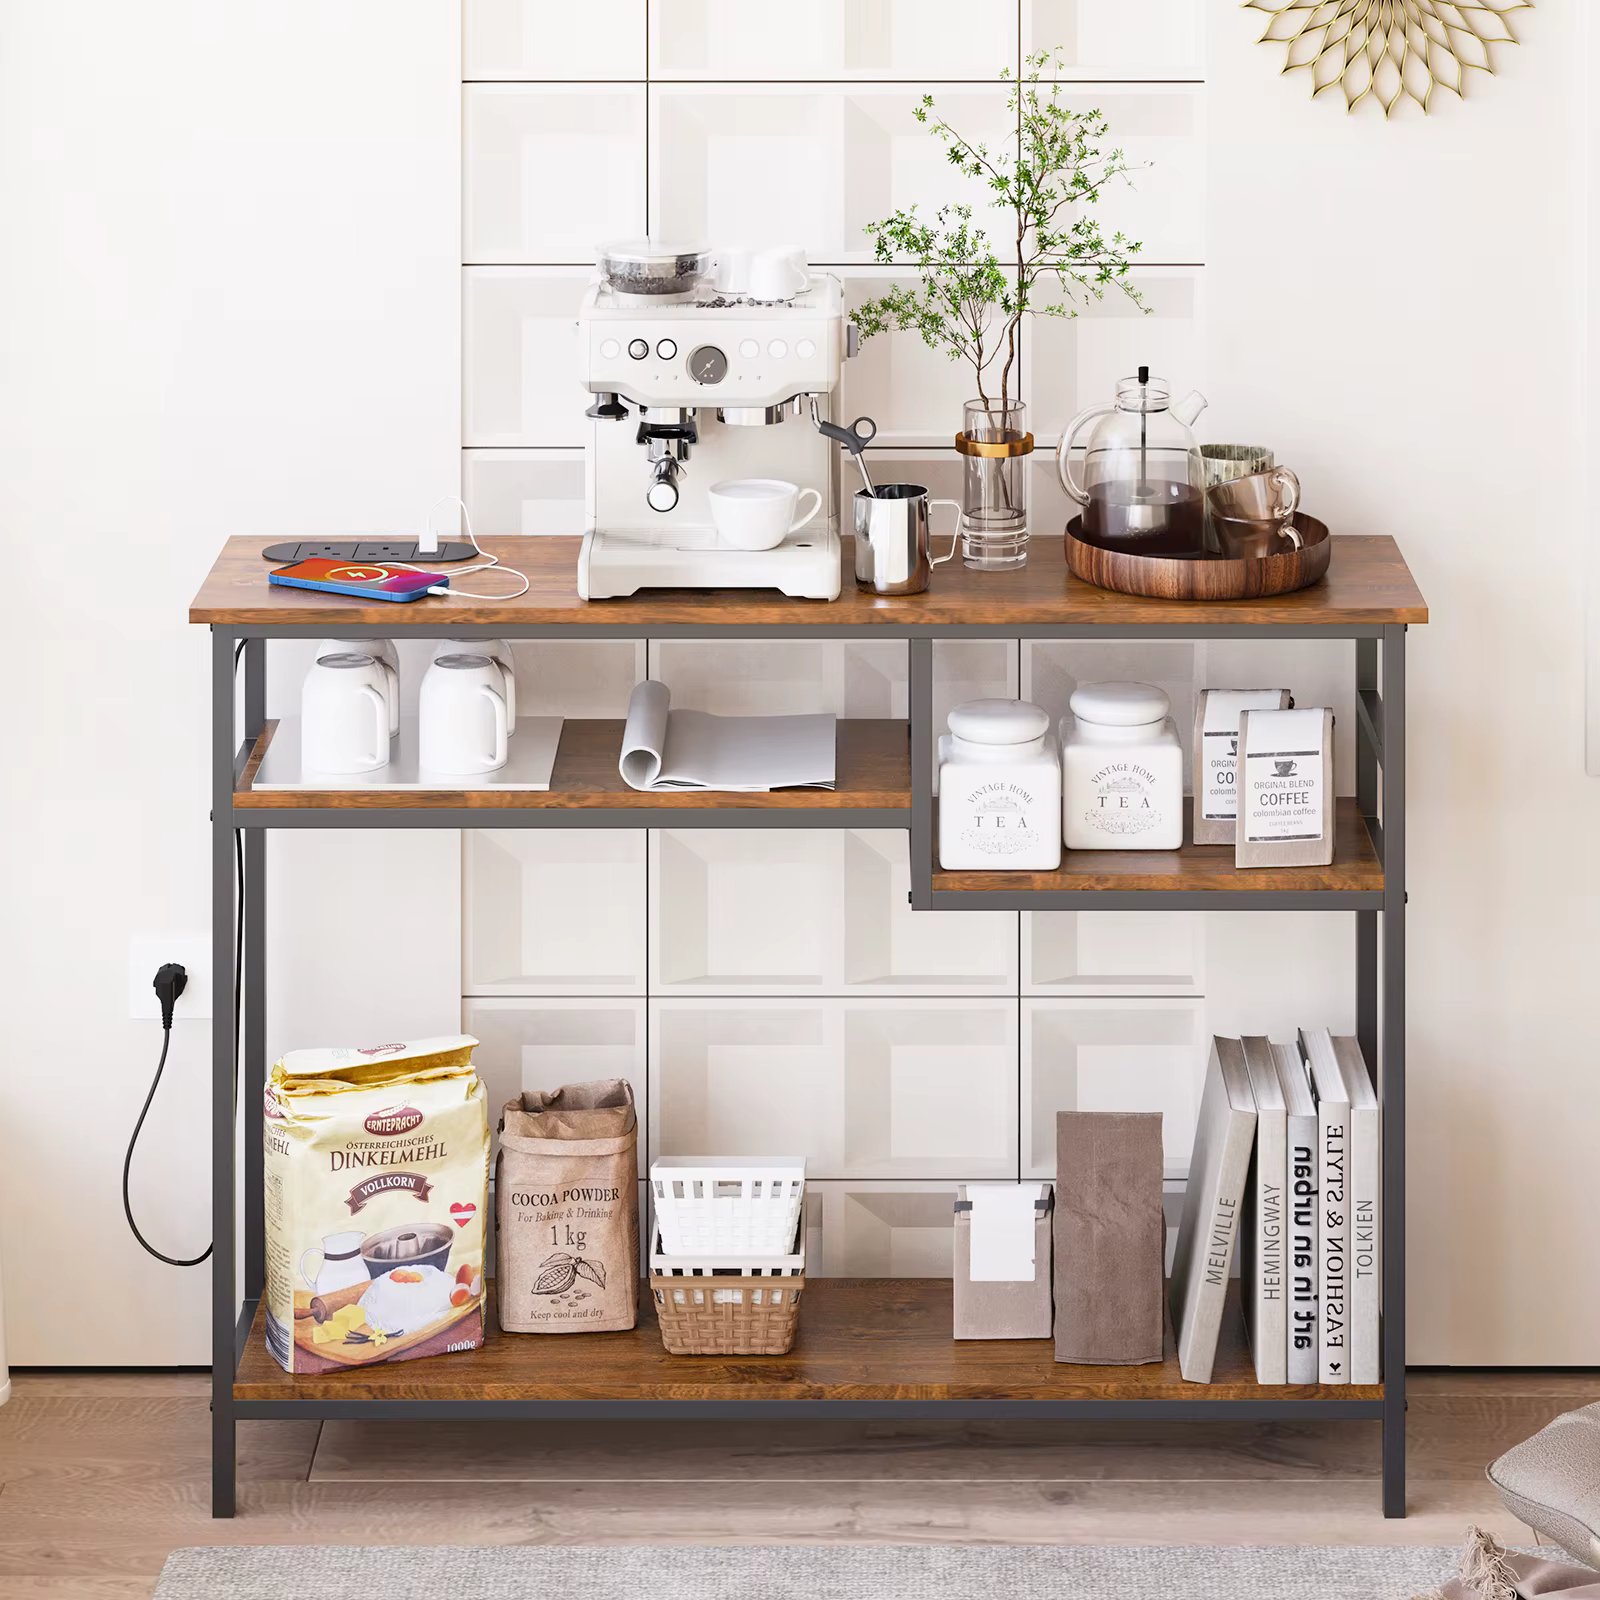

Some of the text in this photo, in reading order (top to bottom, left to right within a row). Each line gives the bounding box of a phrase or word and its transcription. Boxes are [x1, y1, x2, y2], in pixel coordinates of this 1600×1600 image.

[1091, 764, 1158, 786] VINTAGE HOME
[968, 782, 1034, 805] VINTAGE HOME
[1254, 780, 1314, 790] ORGINAL BLEND
[1260, 792, 1310, 806] COFFEE
[1252, 808, 1316, 818] colombian coffee
[366, 1114, 421, 1132] ERNTEPRACHT
[346, 1134, 435, 1150] ÖSTERREICHISCHES
[330, 1142, 448, 1172] DINKELMEHL
[360, 1176, 416, 1196] VOLLKORN
[511, 1188, 620, 1206] COCOA POWDER
[517, 1207, 614, 1222] For Baking & Drinking
[550, 1224, 587, 1250] 1 kg
[1205, 1197, 1236, 1286] MELVILLE
[1263, 1184, 1281, 1300] HEMINGWAY
[1356, 1200, 1373, 1280] TOLKIEN
[530, 1308, 604, 1321] Keep cool and dry
